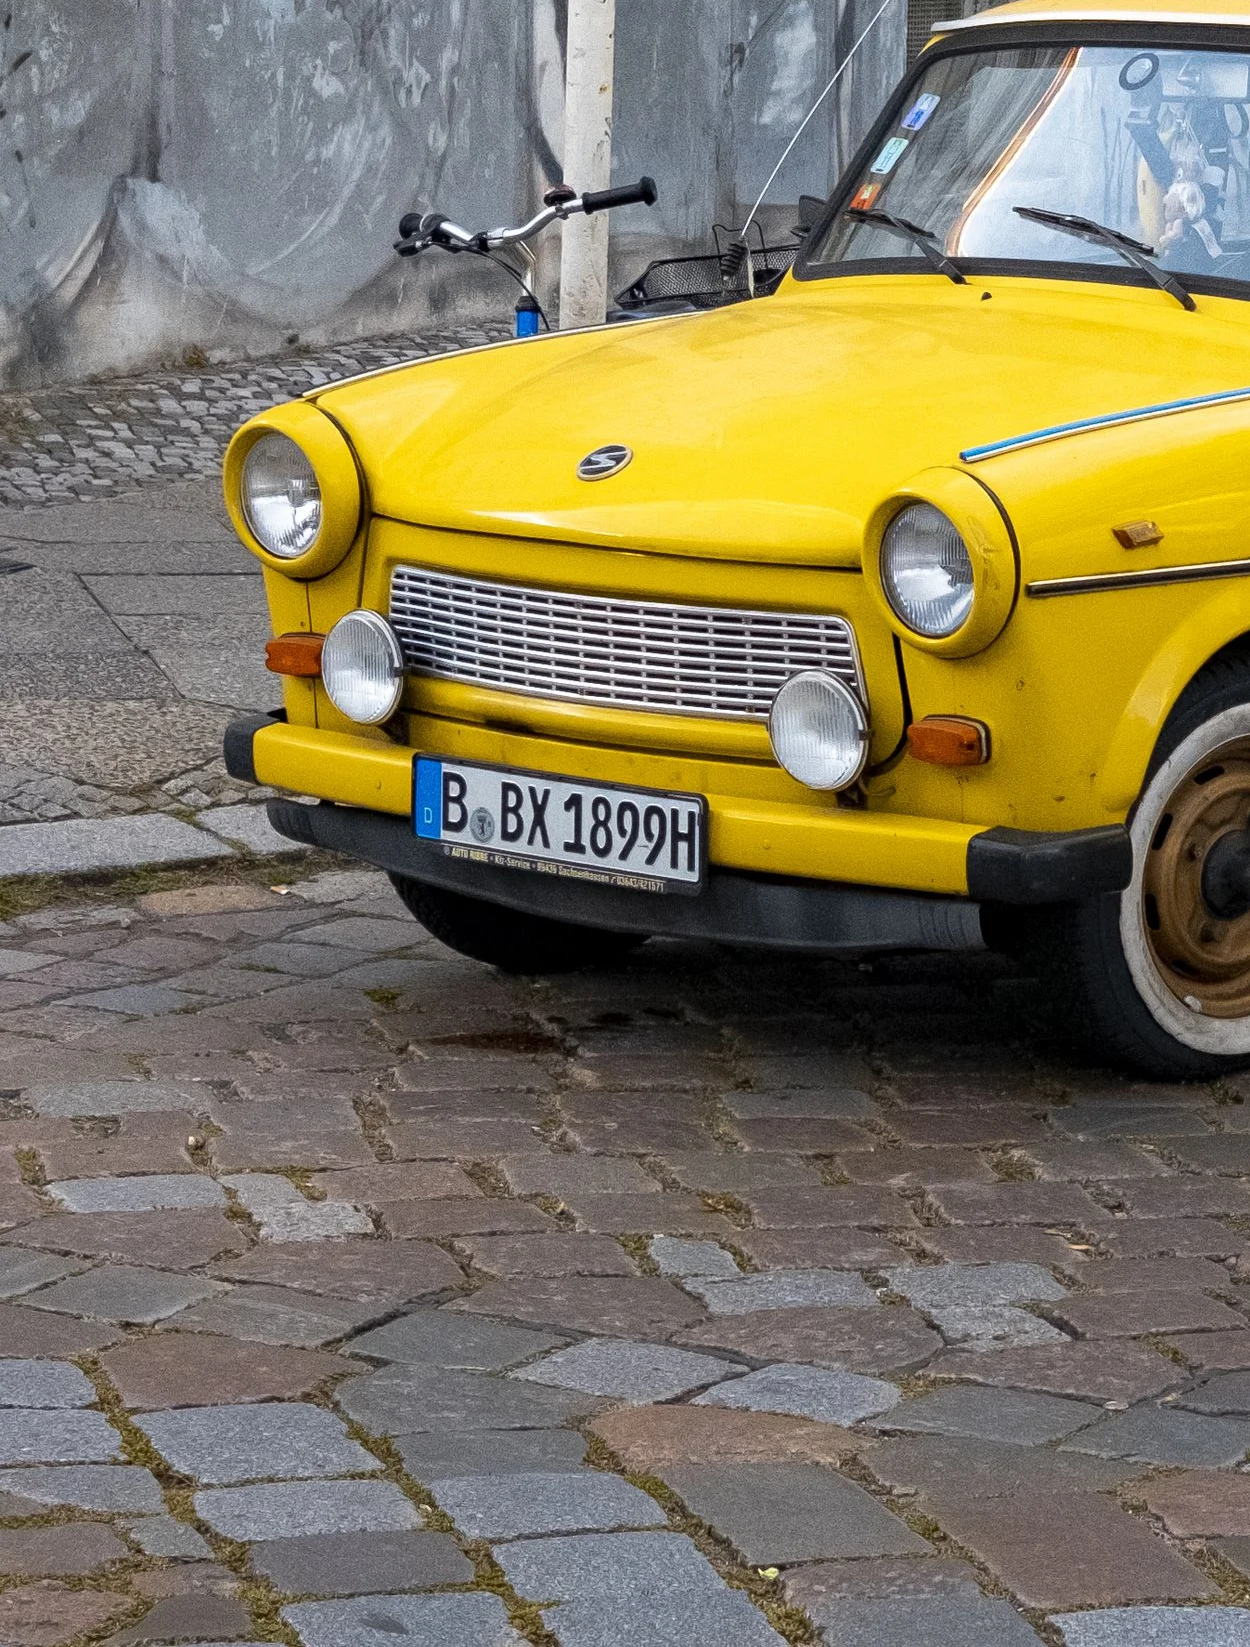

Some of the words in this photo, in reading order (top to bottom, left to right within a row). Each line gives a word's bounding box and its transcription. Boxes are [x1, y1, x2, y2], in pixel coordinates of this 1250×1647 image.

[424, 807, 433, 824] D
[442, 770, 468, 833] B
[500, 780, 550, 849] BX
[562, 792, 696, 872] 1899H
[451, 847, 469, 859] AUTO
